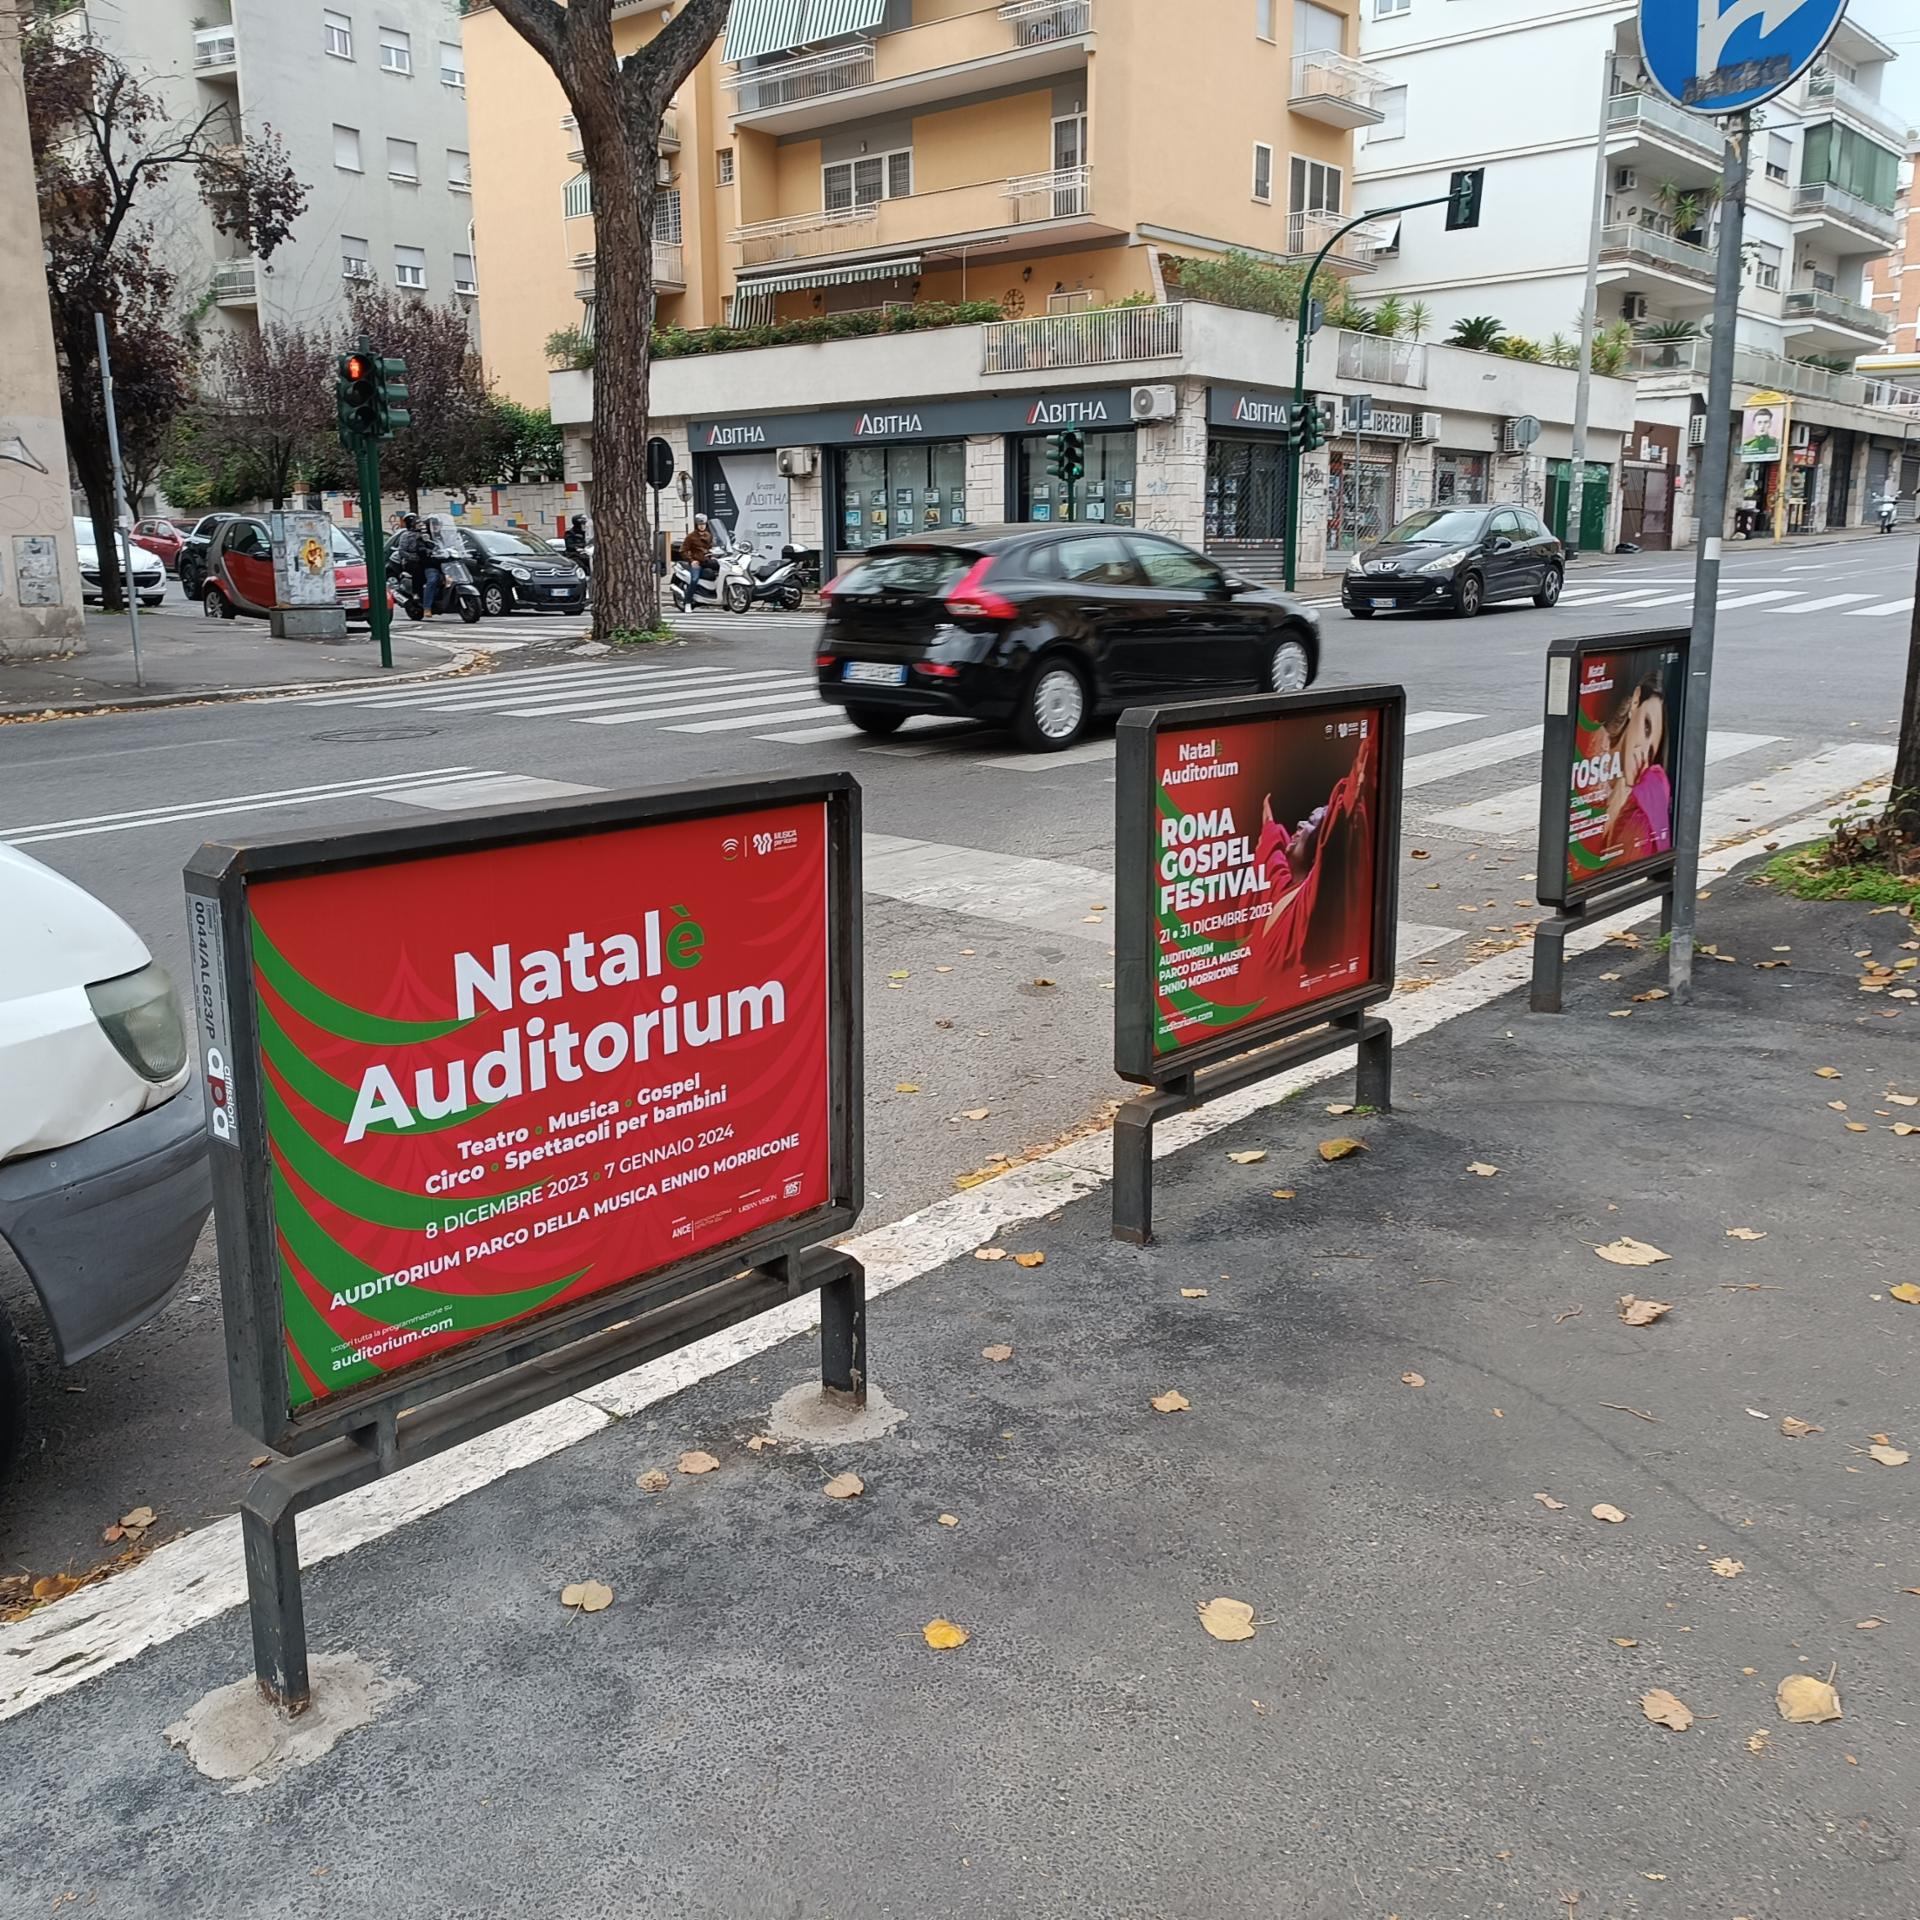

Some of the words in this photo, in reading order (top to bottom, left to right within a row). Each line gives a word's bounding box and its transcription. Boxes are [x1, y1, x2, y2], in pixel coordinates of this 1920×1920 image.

[858, 413, 923, 436] ABITHA
[1032, 400, 1108, 425] ABITHA
[1236, 396, 1287, 425] ABITHA
[1368, 412, 1411, 434] IBRERIA
[710, 425, 766, 446] ABITHA
[1161, 760, 1239, 787] Auditorium
[1161, 807, 1236, 848] ROMA
[1160, 836, 1255, 881] GOSPEL
[1160, 863, 1272, 915] FESTIVAL
[1159, 928, 1171, 944] 21
[1180, 923, 1191, 939] 31
[1193, 908, 1248, 936] DICEMBRE
[1249, 902, 1273, 920] 2023
[453, 903, 705, 1022] Natalè
[1159, 942, 1215, 967] AUDITORIUM
[1159, 964, 1189, 982] PARCO
[1190, 956, 1218, 973] DELLA
[1219, 946, 1252, 965] MUSICA
[1159, 979, 1187, 996] ENNIO
[1188, 963, 1240, 988] MORRICONE
[343, 979, 786, 1144] Auditorium
[206, 1047, 230, 1140] apa
[457, 1127, 530, 1160] Teatro
[548, 1100, 620, 1133] Musica
[637, 1072, 701, 1106] Gospel
[425, 1165, 486, 1194] Circo
[504, 1119, 611, 1171] Spettacoli
[615, 1113, 648, 1139] per
[653, 1084, 728, 1124] bambini
[425, 1221, 438, 1240] 8
[444, 1186, 544, 1233] DICEMBRE
[547, 1171, 590, 1199] 2023
[604, 1162, 616, 1179] 7
[619, 1137, 695, 1174] GENNAIO
[698, 1123, 735, 1149] 2024
[330, 1251, 461, 1311] AUDITORIUM
[465, 1228, 529, 1263] PARCO
[534, 1207, 590, 1239] DELLA
[593, 1183, 658, 1217] MUSICA
[661, 1164, 711, 1193] ENNIO
[713, 1133, 801, 1175] MORRICONE
[671, 1223, 691, 1239] ANCE
[331, 1340, 354, 1354] scopri
[354, 1333, 373, 1345] tutta
[374, 1329, 381, 1338] la
[381, 1308, 443, 1336] programmazione
[332, 1317, 454, 1371] auditorium.com
